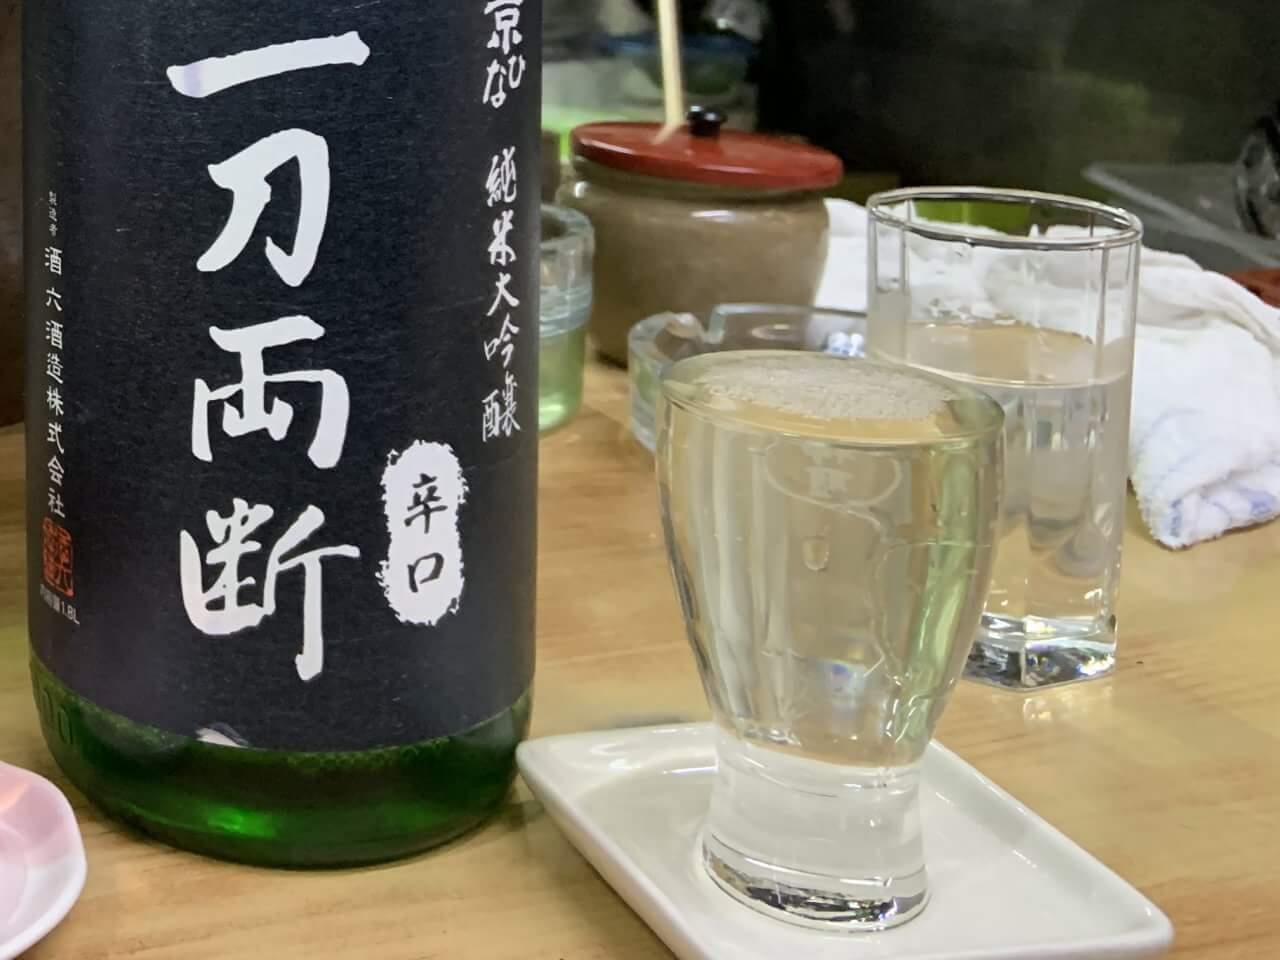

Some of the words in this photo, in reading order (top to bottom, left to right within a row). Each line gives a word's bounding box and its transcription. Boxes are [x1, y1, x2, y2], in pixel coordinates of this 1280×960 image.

[44, 246, 65, 519] 酒六酒造株式会社
[167, 31, 371, 682] 一刀両断
[402, 474, 450, 596] 辛口
